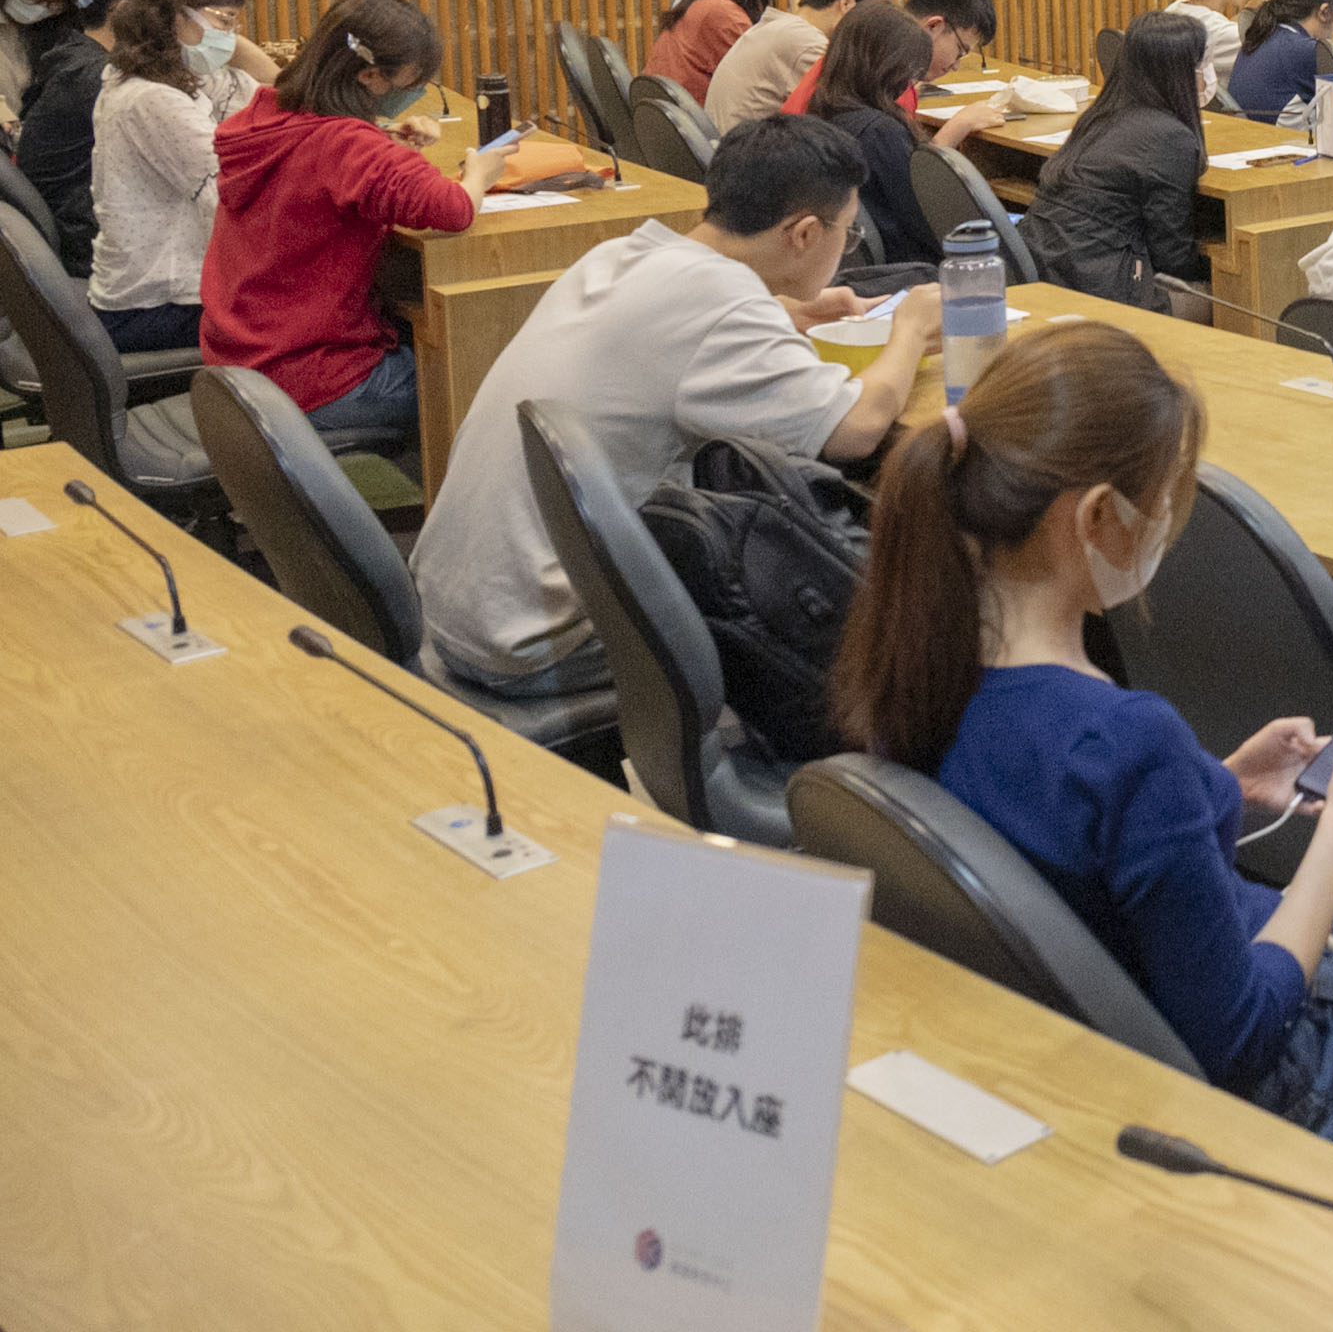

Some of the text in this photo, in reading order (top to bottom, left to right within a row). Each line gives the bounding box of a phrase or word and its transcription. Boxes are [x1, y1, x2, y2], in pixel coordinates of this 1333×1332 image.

[680, 1005, 743, 1053] 此排
[627, 1056, 783, 1139] 不開放入座
